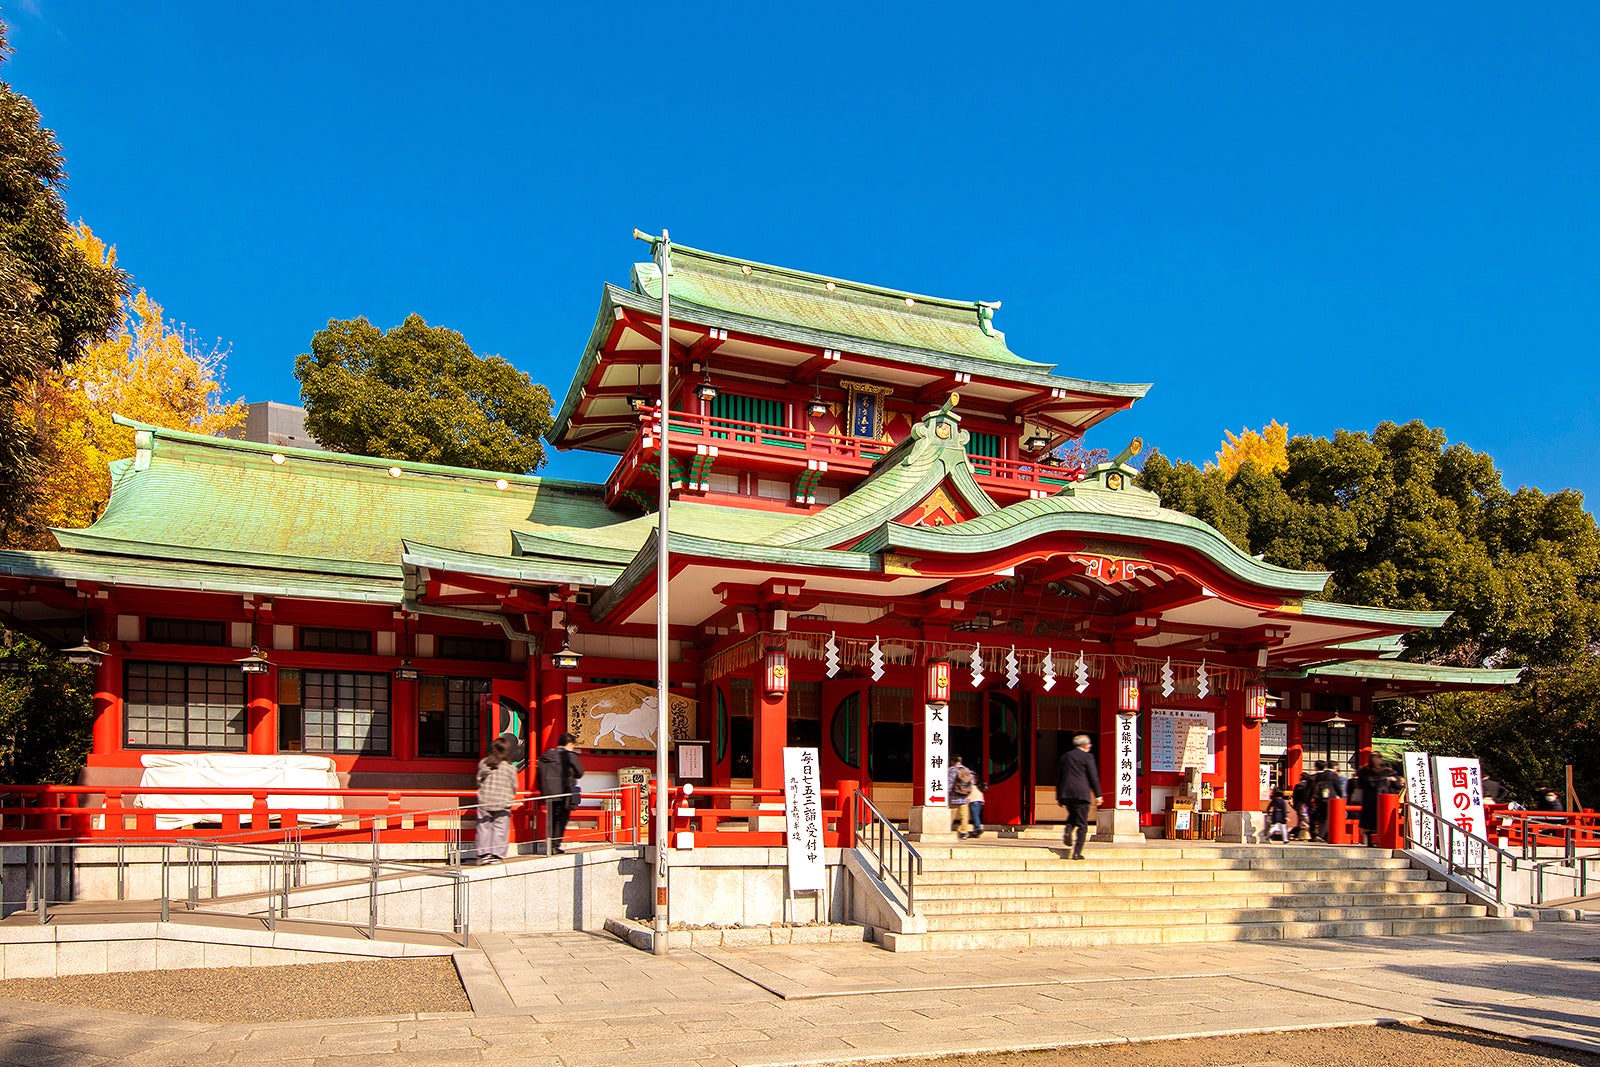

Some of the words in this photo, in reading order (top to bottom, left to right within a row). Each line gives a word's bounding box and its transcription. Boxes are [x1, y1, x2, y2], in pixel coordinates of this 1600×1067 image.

[931, 708, 944, 792] 大鳥神社
[1121, 719, 1132, 796] 古熊手納め所
[1469, 767, 1481, 806] 深川八幡
[801, 751, 818, 863] 毎日七五三詣受付中
[1449, 767, 1474, 838] 酉の市
